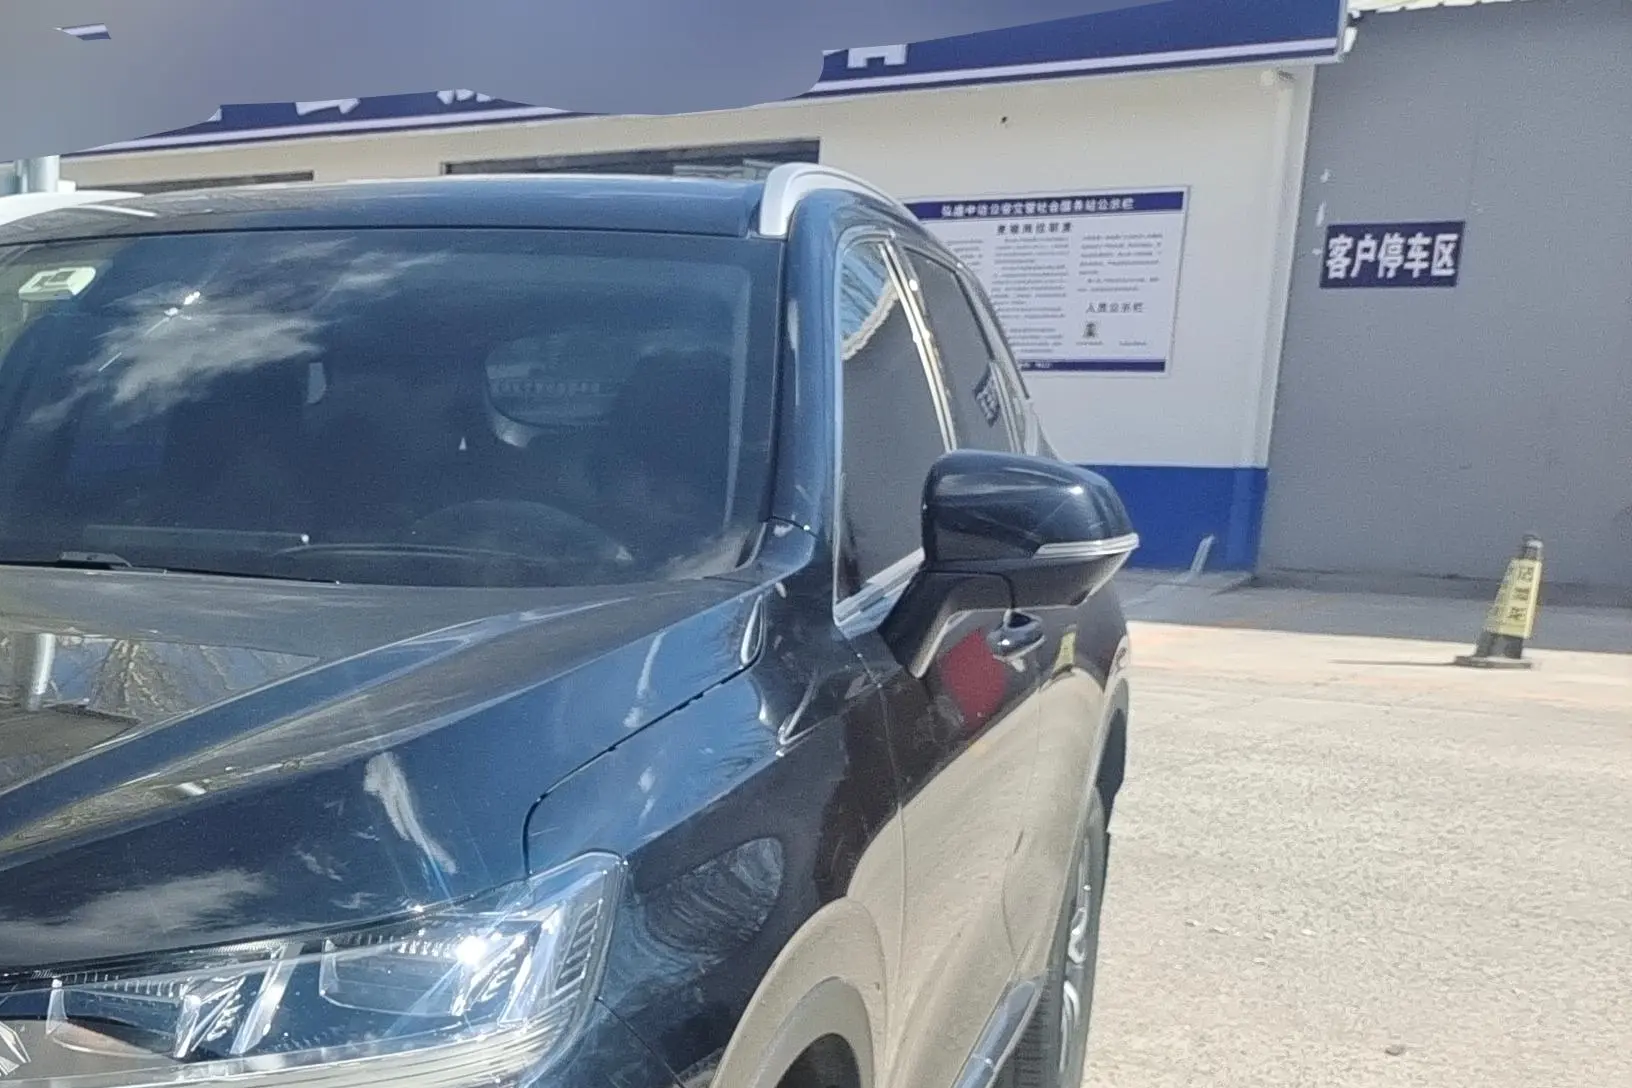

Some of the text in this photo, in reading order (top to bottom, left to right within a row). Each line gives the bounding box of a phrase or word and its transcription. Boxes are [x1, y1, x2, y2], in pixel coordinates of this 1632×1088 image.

[1325, 231, 1460, 279] 客户停车区
